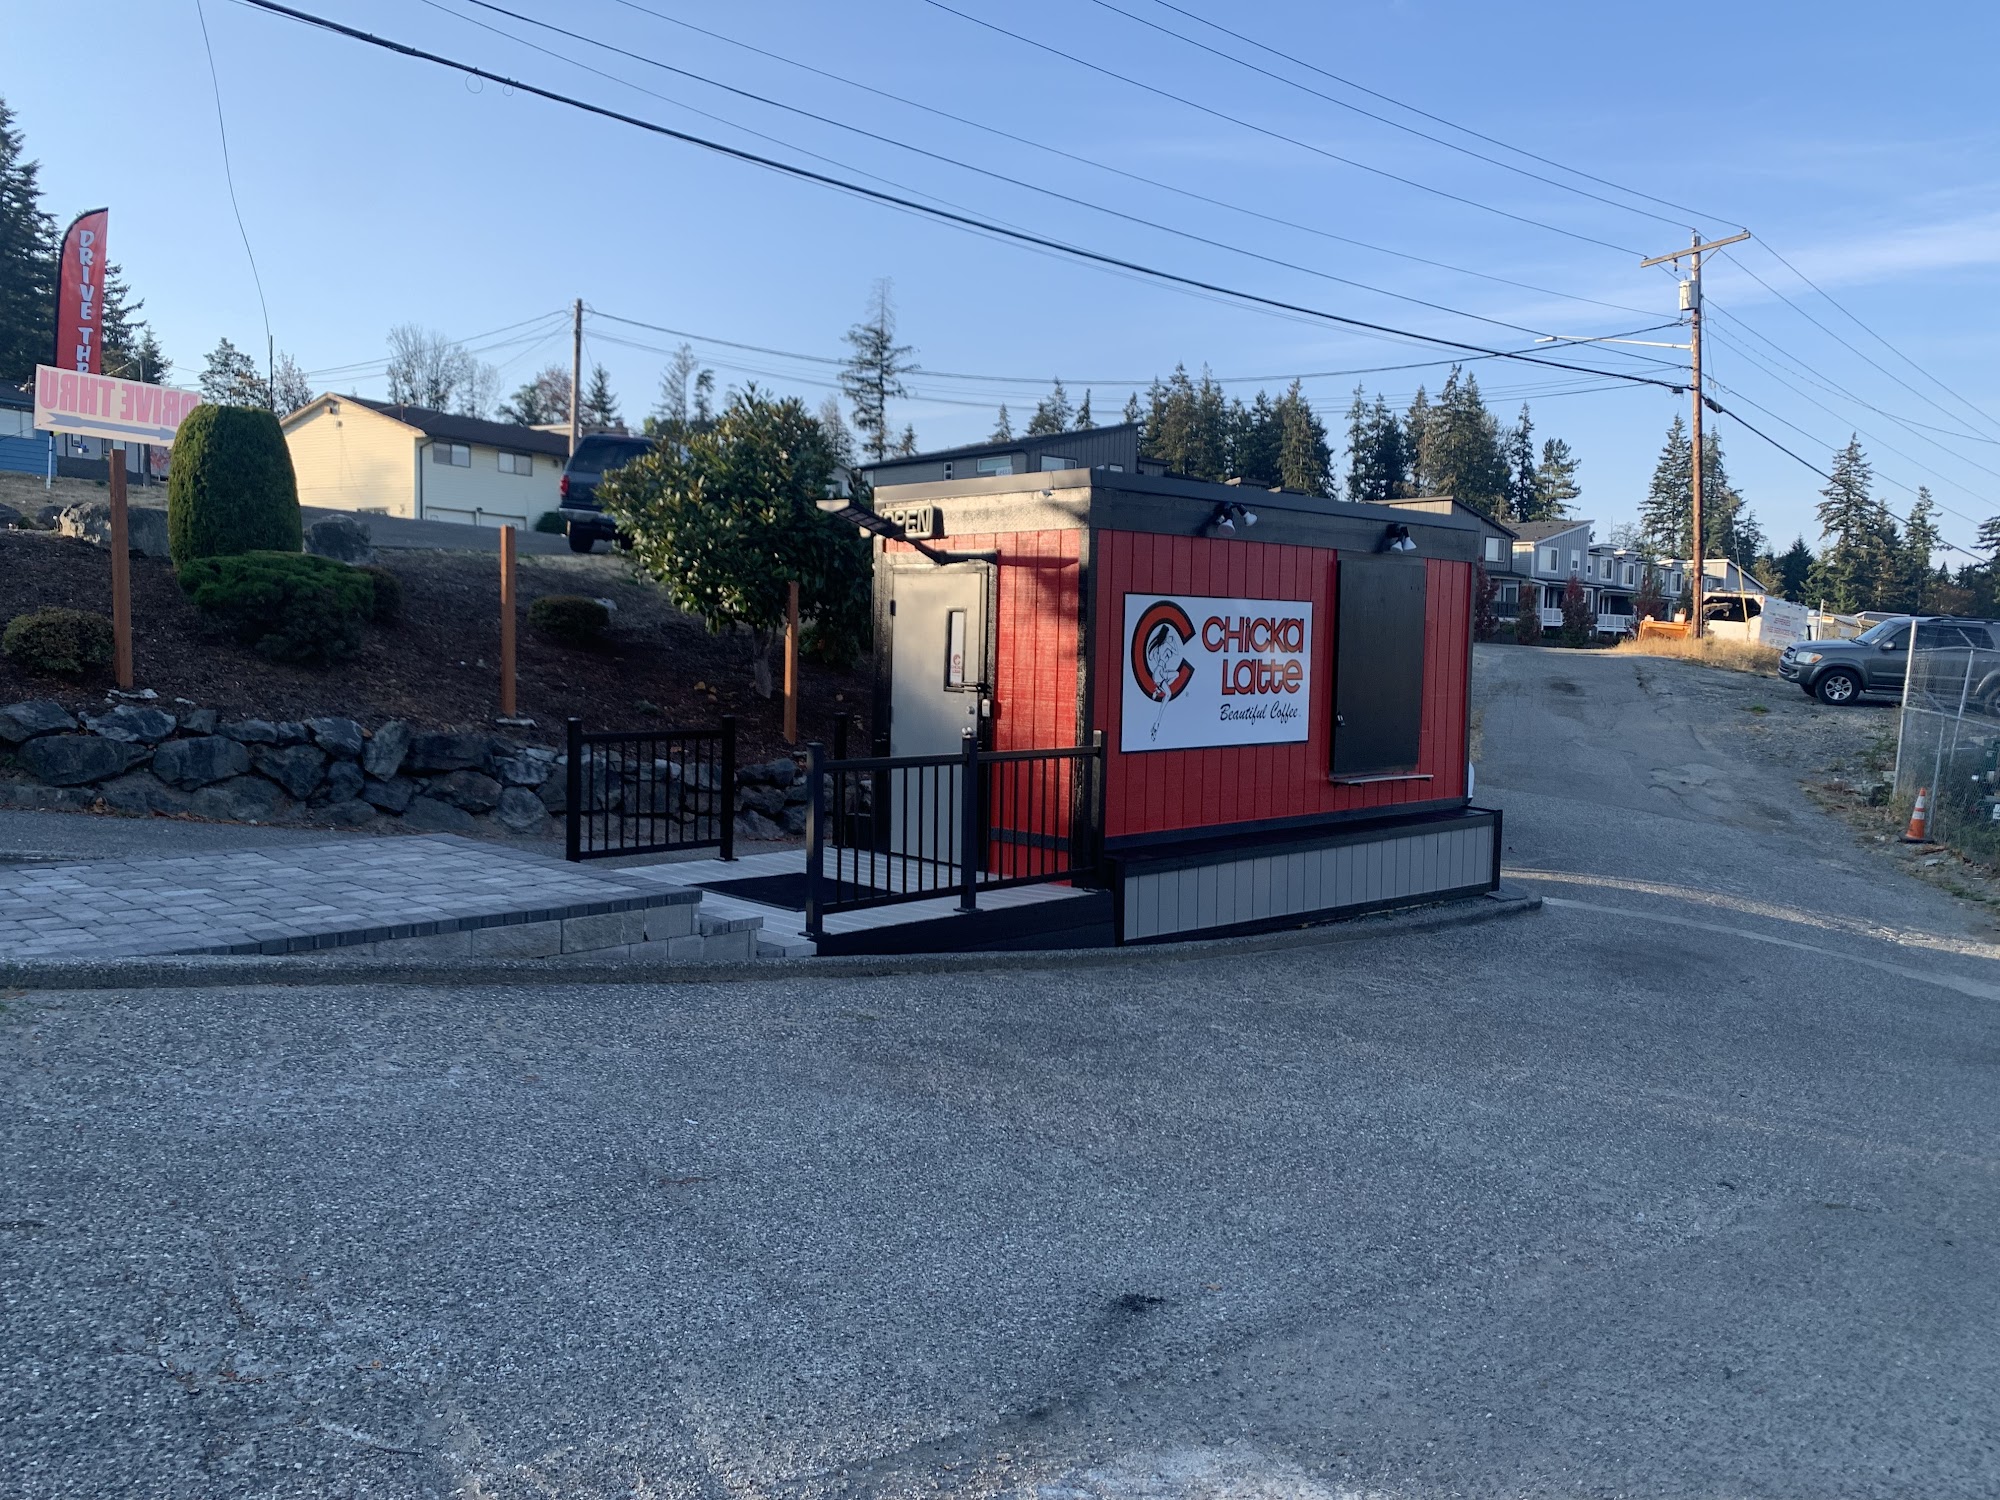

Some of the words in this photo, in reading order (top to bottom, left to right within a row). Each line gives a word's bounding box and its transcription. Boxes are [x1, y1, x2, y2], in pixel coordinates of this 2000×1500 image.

[79, 230, 95, 320] DRIVE
[1220, 703, 1267, 725] Beautiful
[1270, 700, 1298, 724] Coffee
